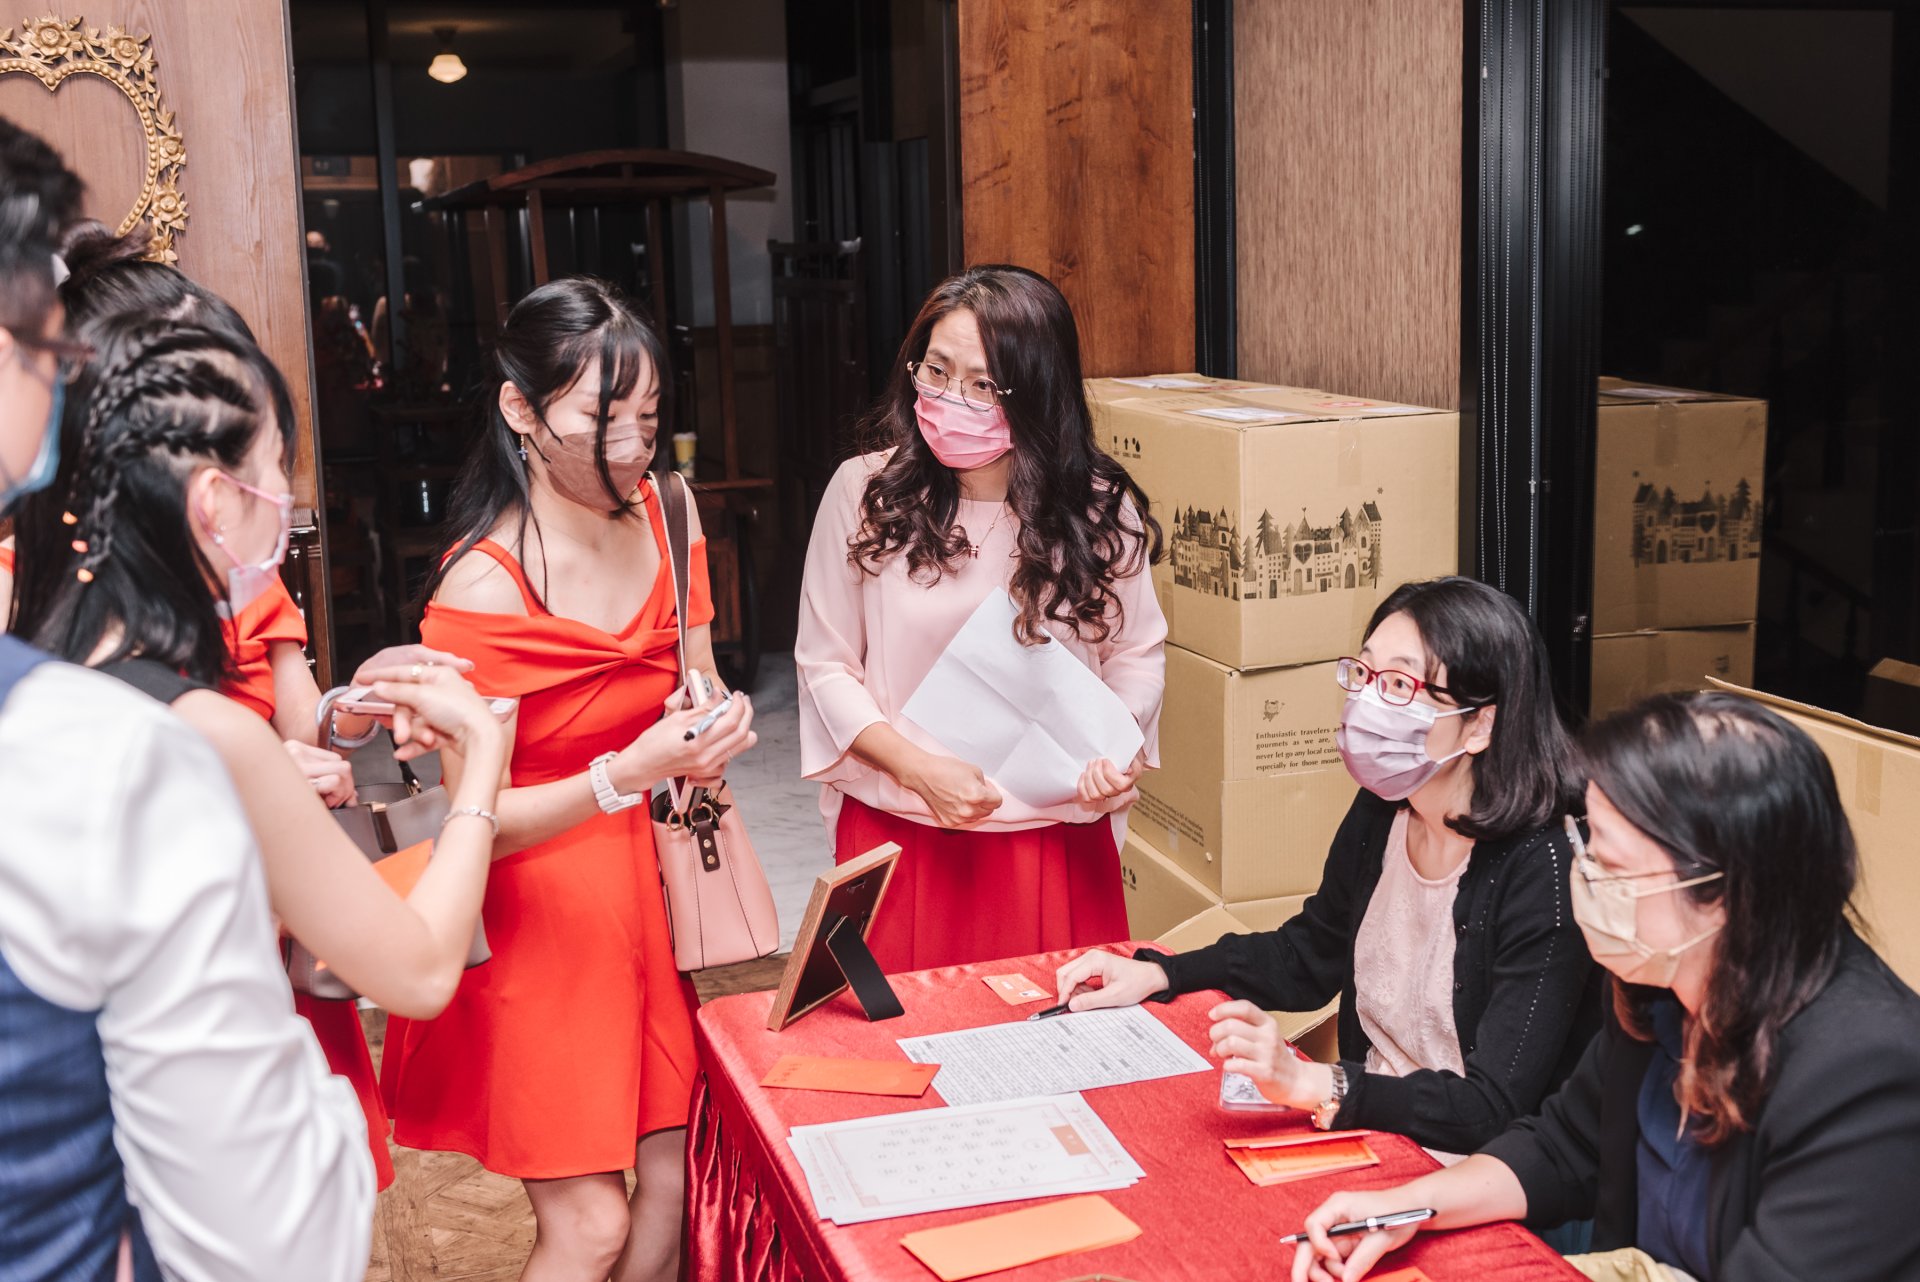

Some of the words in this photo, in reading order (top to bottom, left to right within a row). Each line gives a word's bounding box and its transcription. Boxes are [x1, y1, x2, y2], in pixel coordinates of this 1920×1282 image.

[1256, 730, 1297, 739] Enthusiastic
[1300, 727, 1330, 736] travelers
[1256, 740, 1288, 750] gourmets
[1318, 736, 1330, 744] are,
[1307, 747, 1322, 755] local
[1256, 762, 1286, 772] especially
